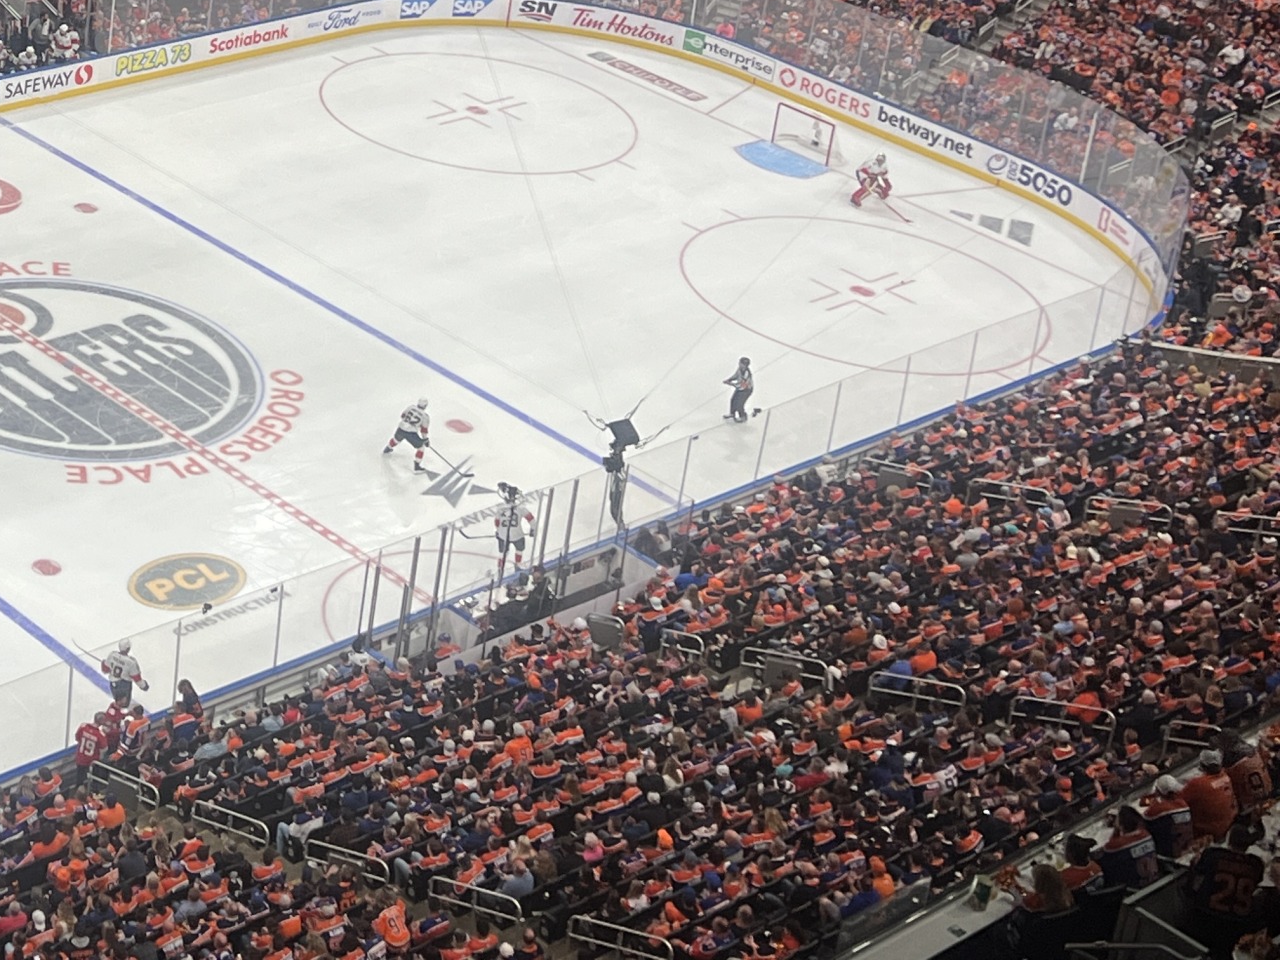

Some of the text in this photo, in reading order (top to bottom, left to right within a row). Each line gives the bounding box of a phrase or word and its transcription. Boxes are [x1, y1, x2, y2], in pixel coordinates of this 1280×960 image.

[323, 8, 362, 31] Ford
[401, 0, 430, 17] SAP
[453, 0, 486, 15] SAP
[519, 0, 558, 16] SN
[209, 24, 289, 54] Scotiabank
[572, 7, 674, 47] Tim Hortons
[116, 43, 191, 77] PIZZA 73
[689, 35, 773, 75] enterprise
[5, 71, 73, 99] SAFEWAY
[800, 77, 870, 118] ROGERS
[878, 106, 974, 159] betway.net
[66, 386, 305, 485] ROGERS PLACE
[145, 563, 230, 602] PCL
[80, 737, 96, 756] 19
